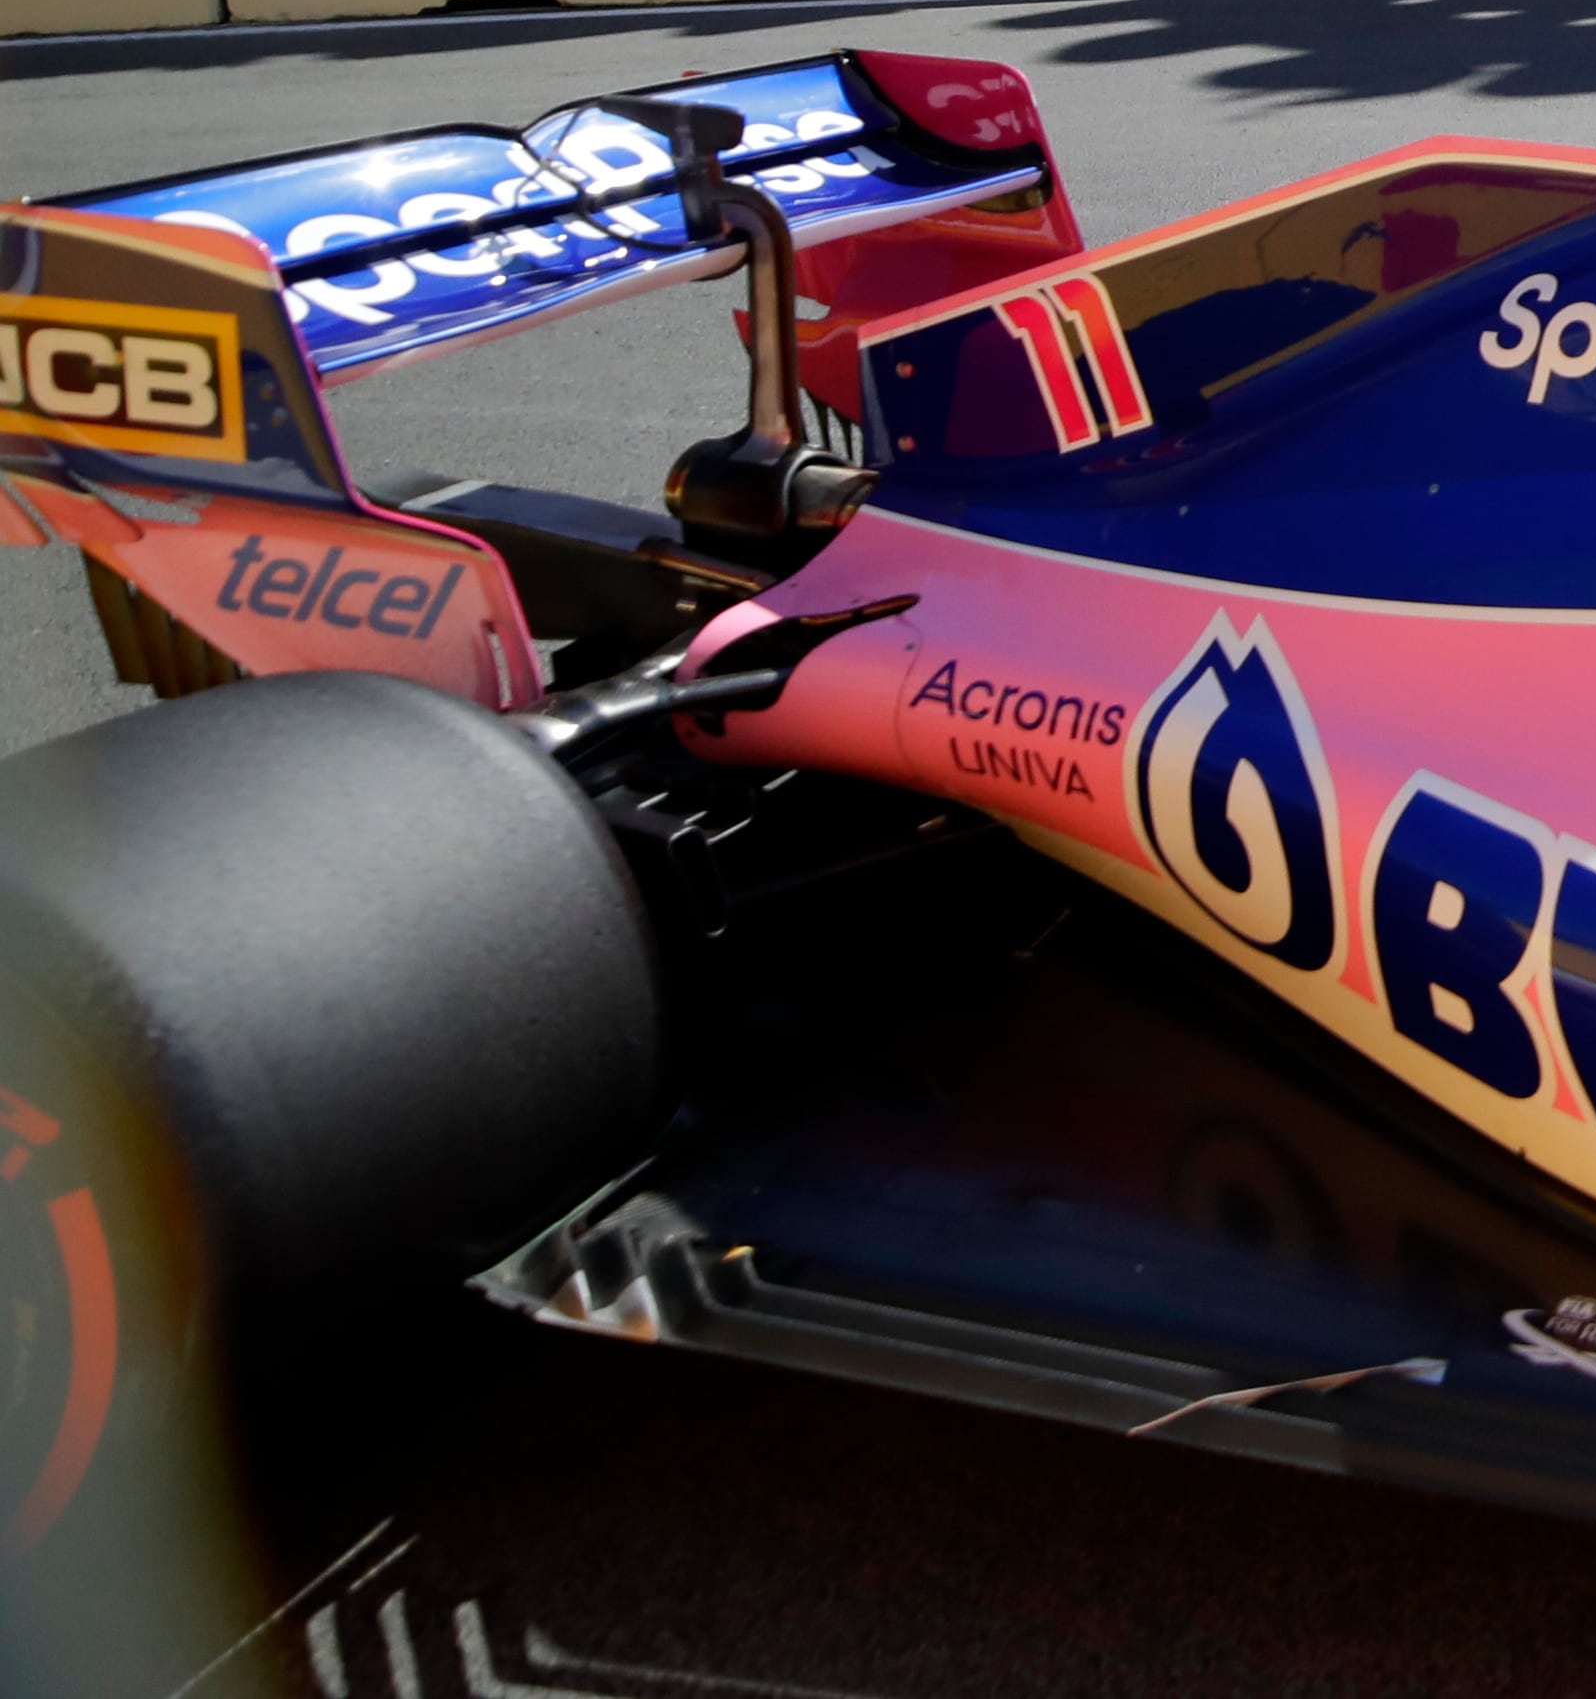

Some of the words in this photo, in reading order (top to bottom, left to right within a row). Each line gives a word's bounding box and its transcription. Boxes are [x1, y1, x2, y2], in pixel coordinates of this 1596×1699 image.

[994, 271, 1154, 454] 11
[217, 535, 465, 639] telcel
[910, 658, 1126, 746] Acronis
